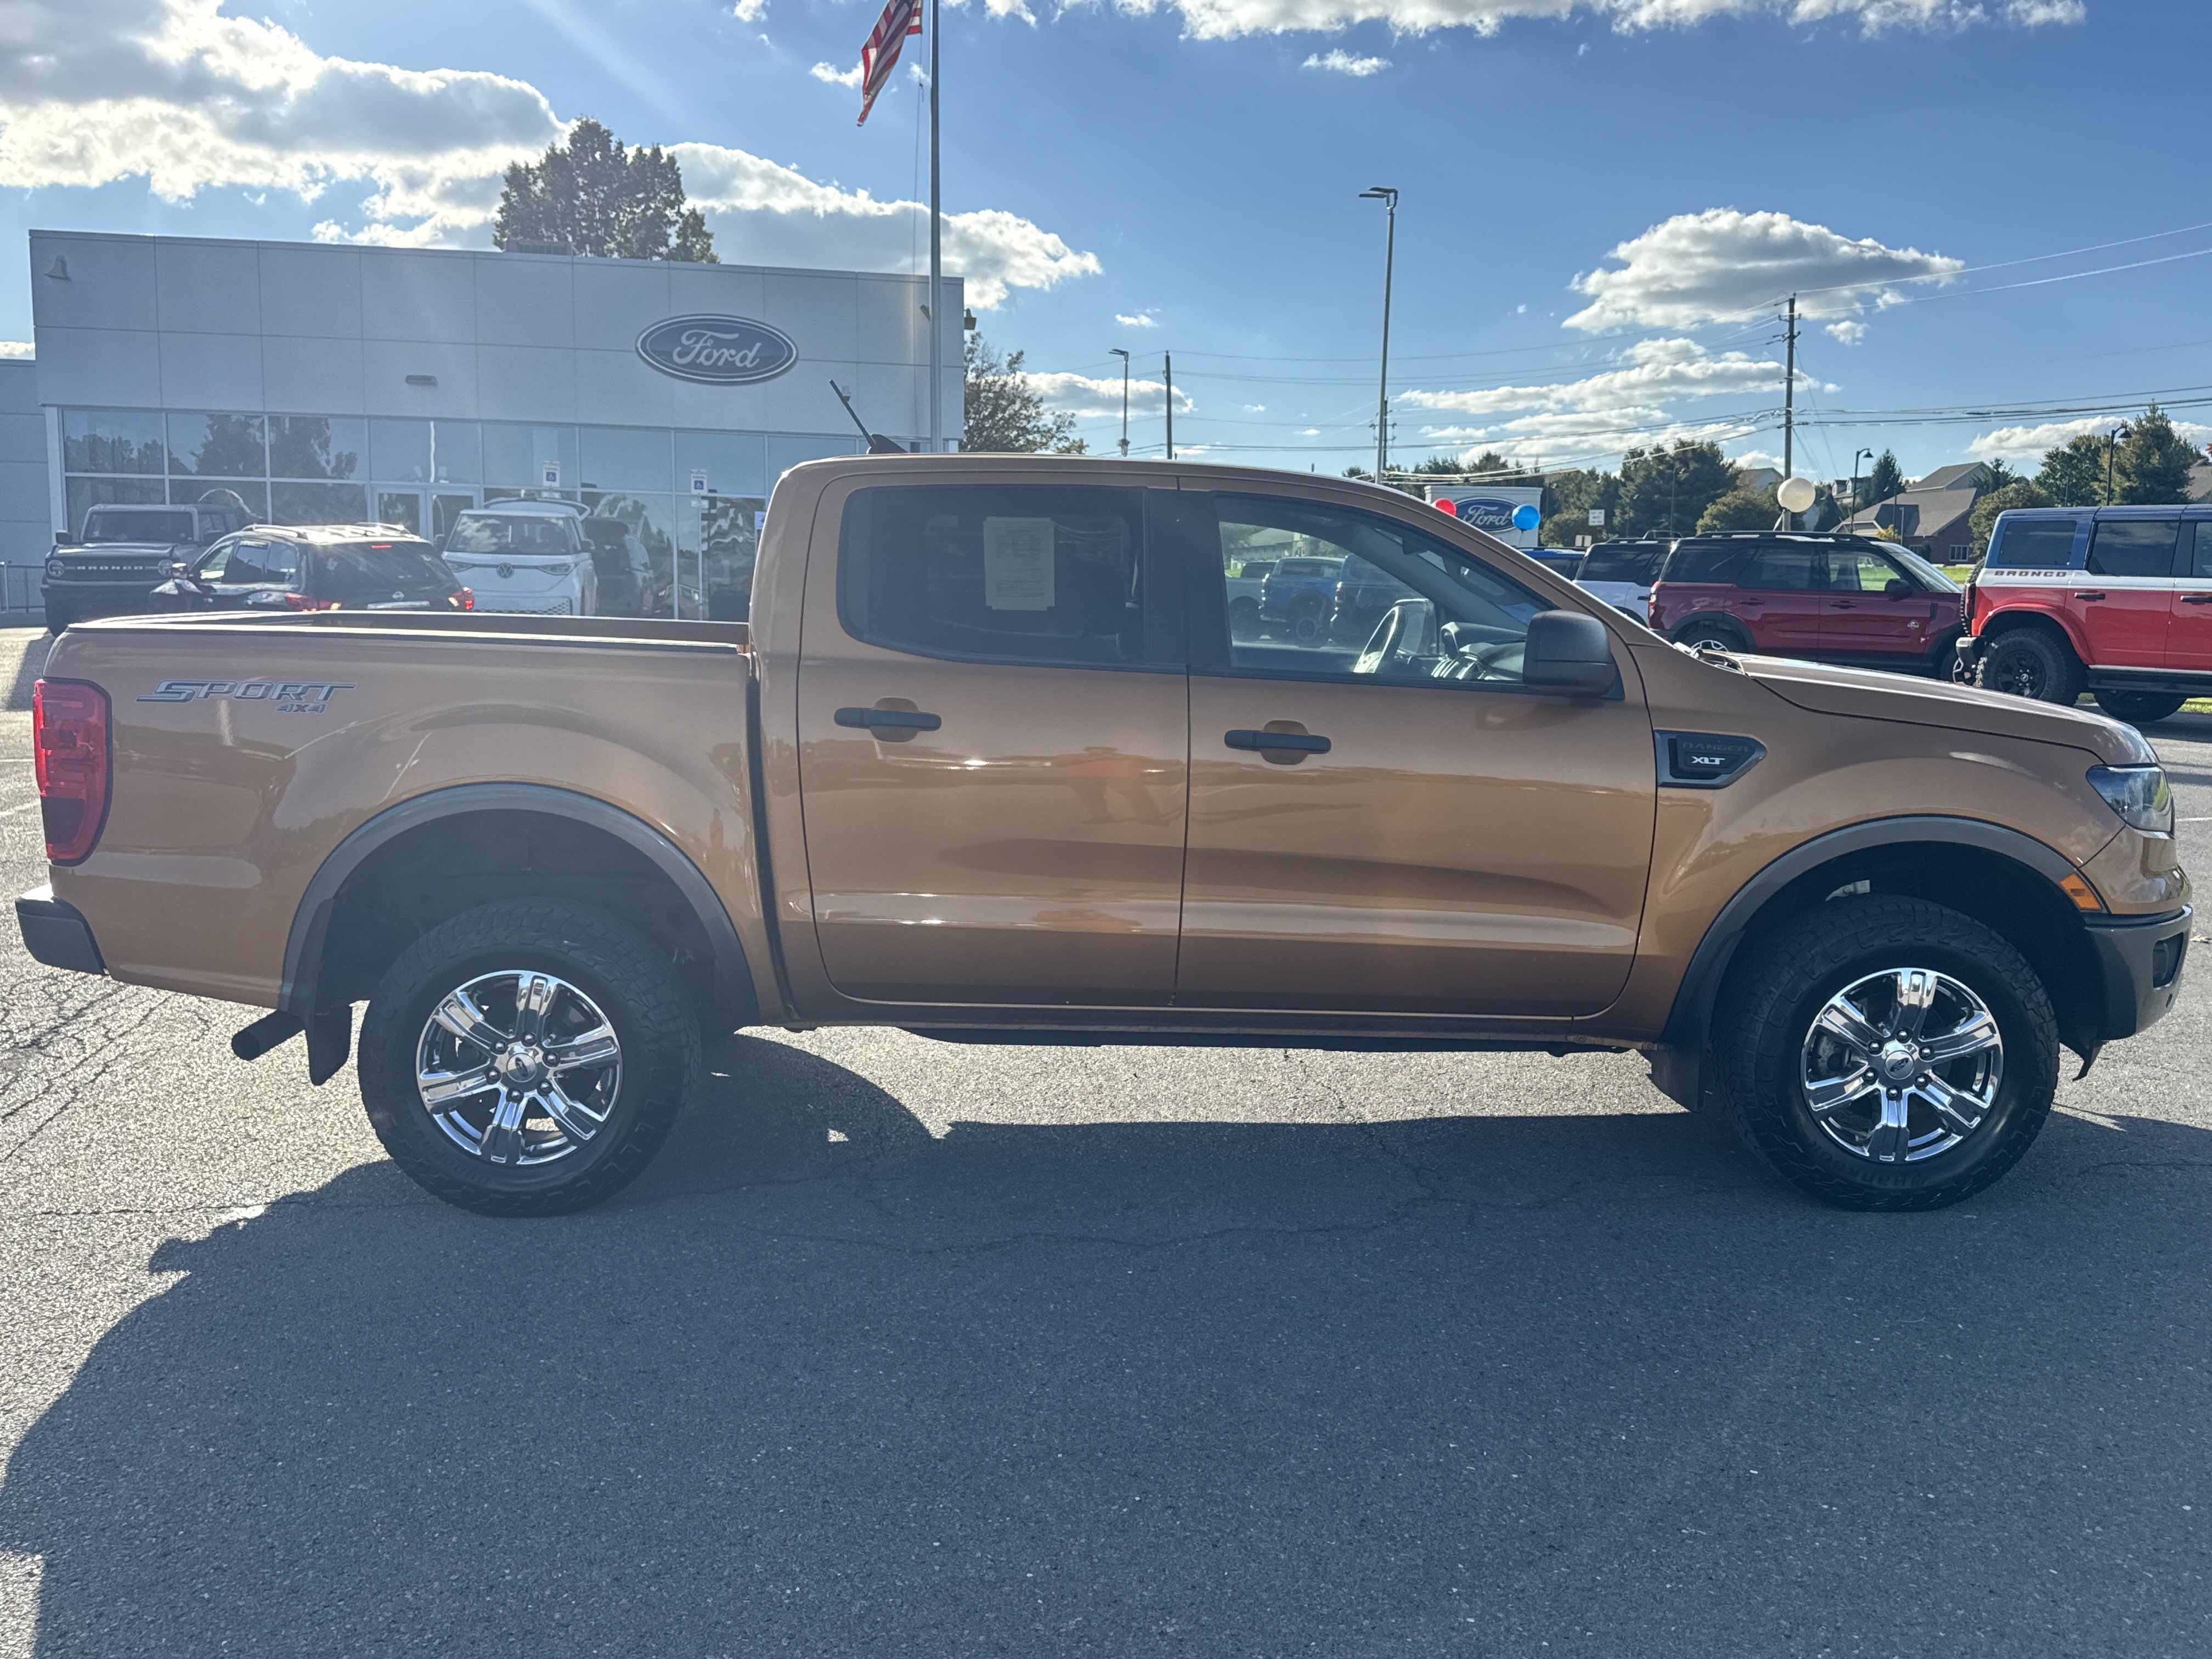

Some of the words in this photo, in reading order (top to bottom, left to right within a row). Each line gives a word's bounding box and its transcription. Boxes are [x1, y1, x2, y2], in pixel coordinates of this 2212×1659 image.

[673, 330, 762, 368] Ford
[1463, 505, 1511, 526] Ford
[135, 679, 357, 704] SPORT
[1691, 756, 1725, 765] XLT
